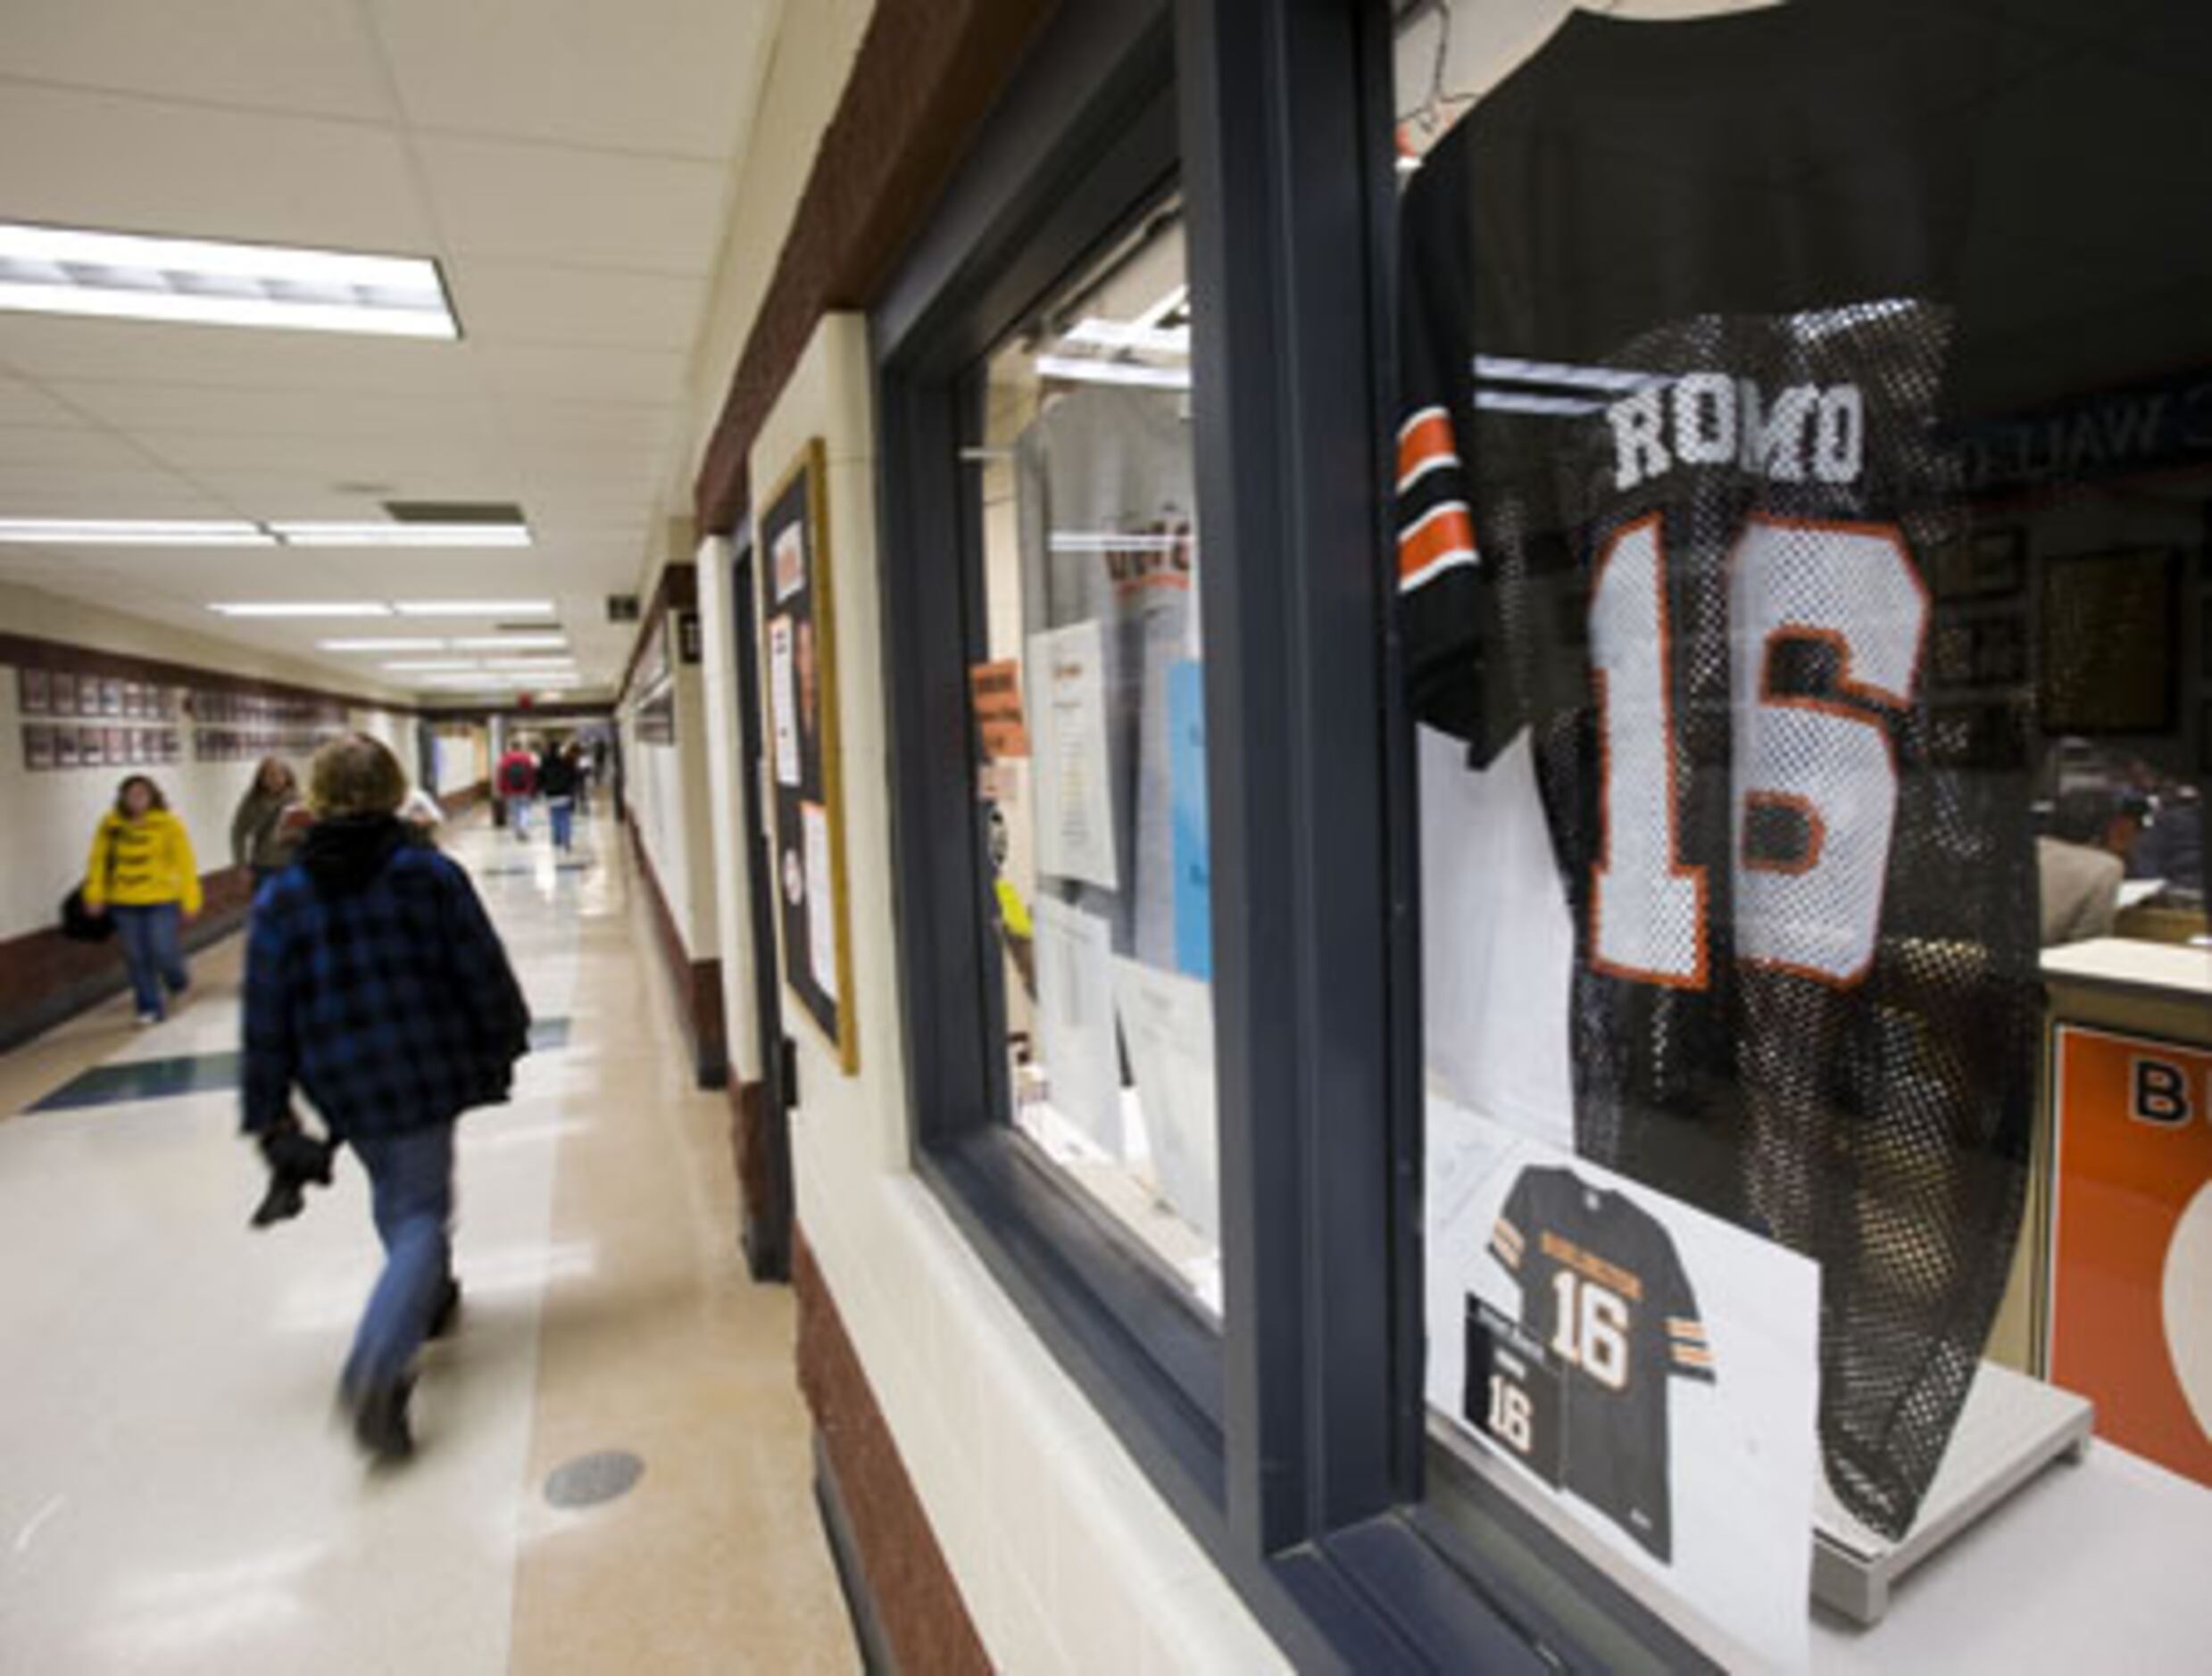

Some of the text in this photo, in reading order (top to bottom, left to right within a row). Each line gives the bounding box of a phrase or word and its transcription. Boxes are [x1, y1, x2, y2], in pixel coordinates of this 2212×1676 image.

[1608, 371, 1863, 491] ROMO
[1588, 510, 1931, 991] 16
[2130, 1057, 2212, 1128] B
[1550, 1268, 1630, 1392] 16
[1487, 1374, 1534, 1453] 16
